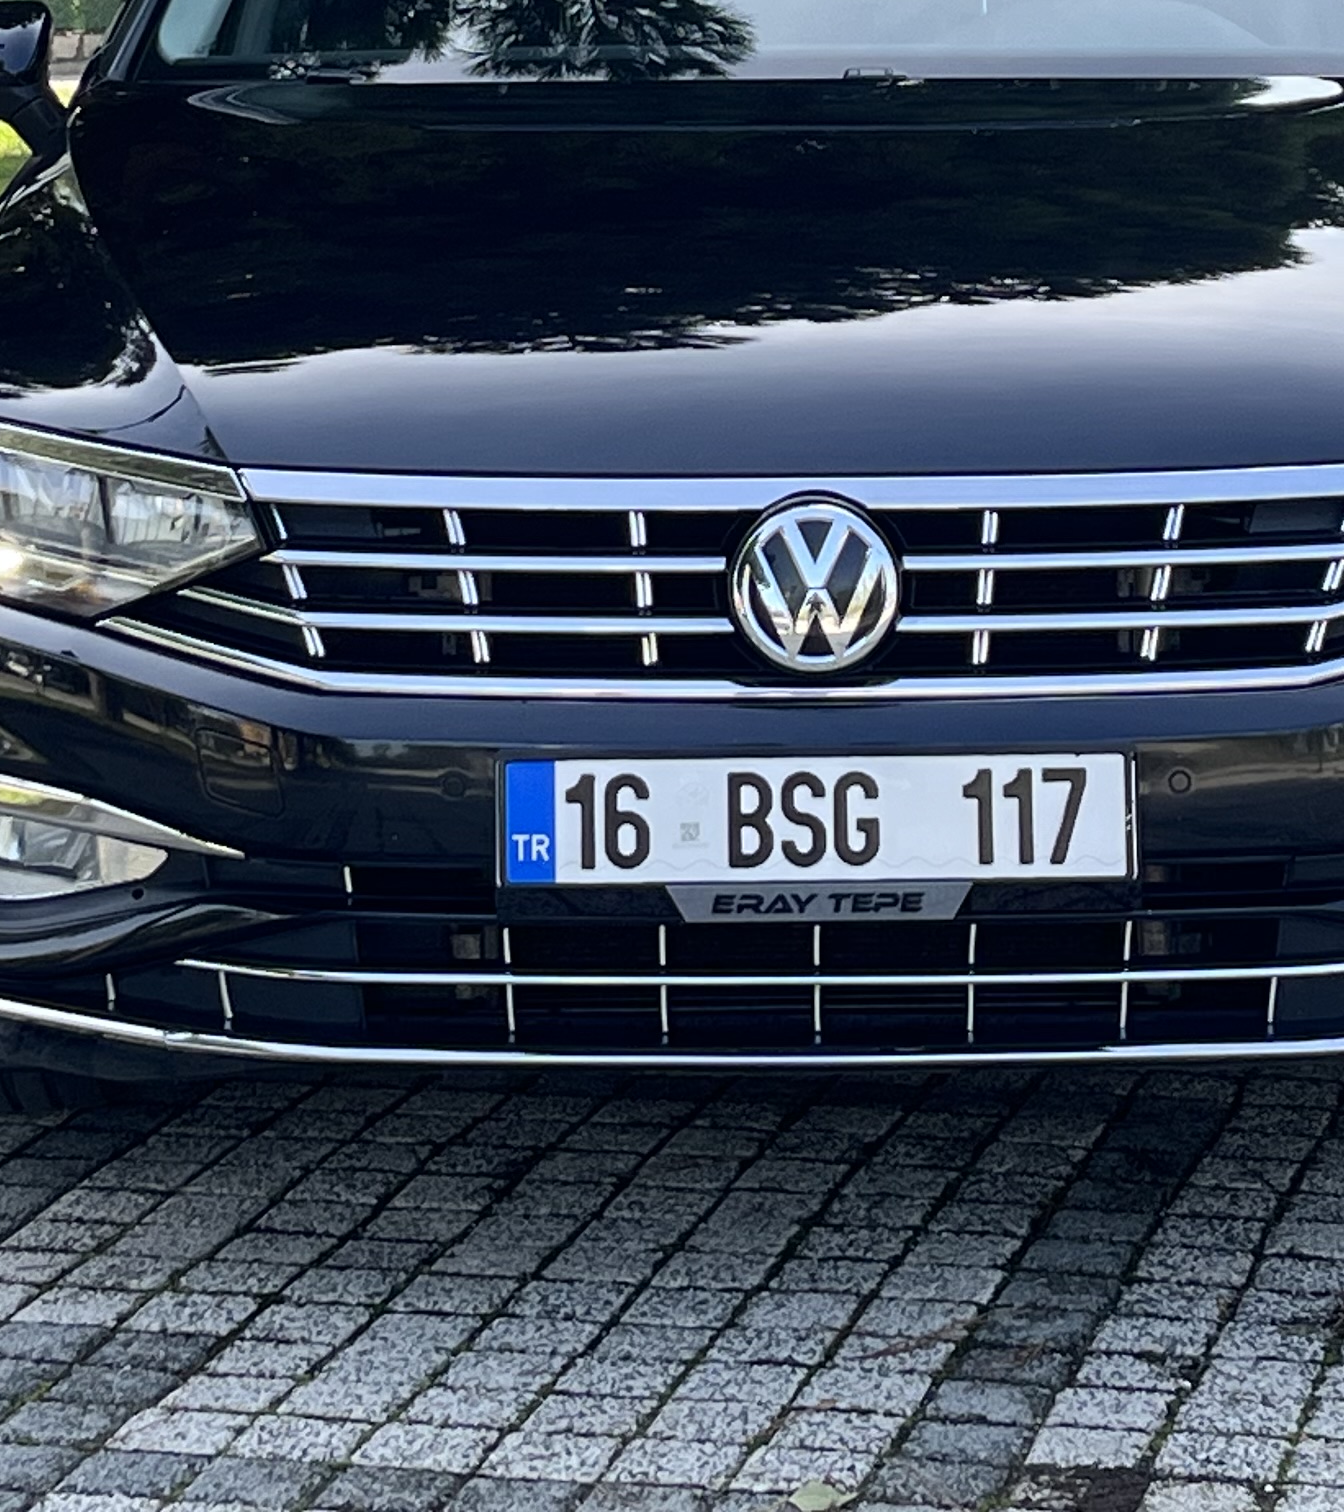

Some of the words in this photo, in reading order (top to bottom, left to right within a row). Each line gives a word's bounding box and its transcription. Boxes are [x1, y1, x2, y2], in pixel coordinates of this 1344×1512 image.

[565, 773, 650, 870] 16
[727, 771, 881, 868] BSG
[962, 767, 1087, 865] 117
[512, 834, 550, 862] TR
[711, 892, 816, 915] ERAY
[827, 892, 924, 914] TEPE
